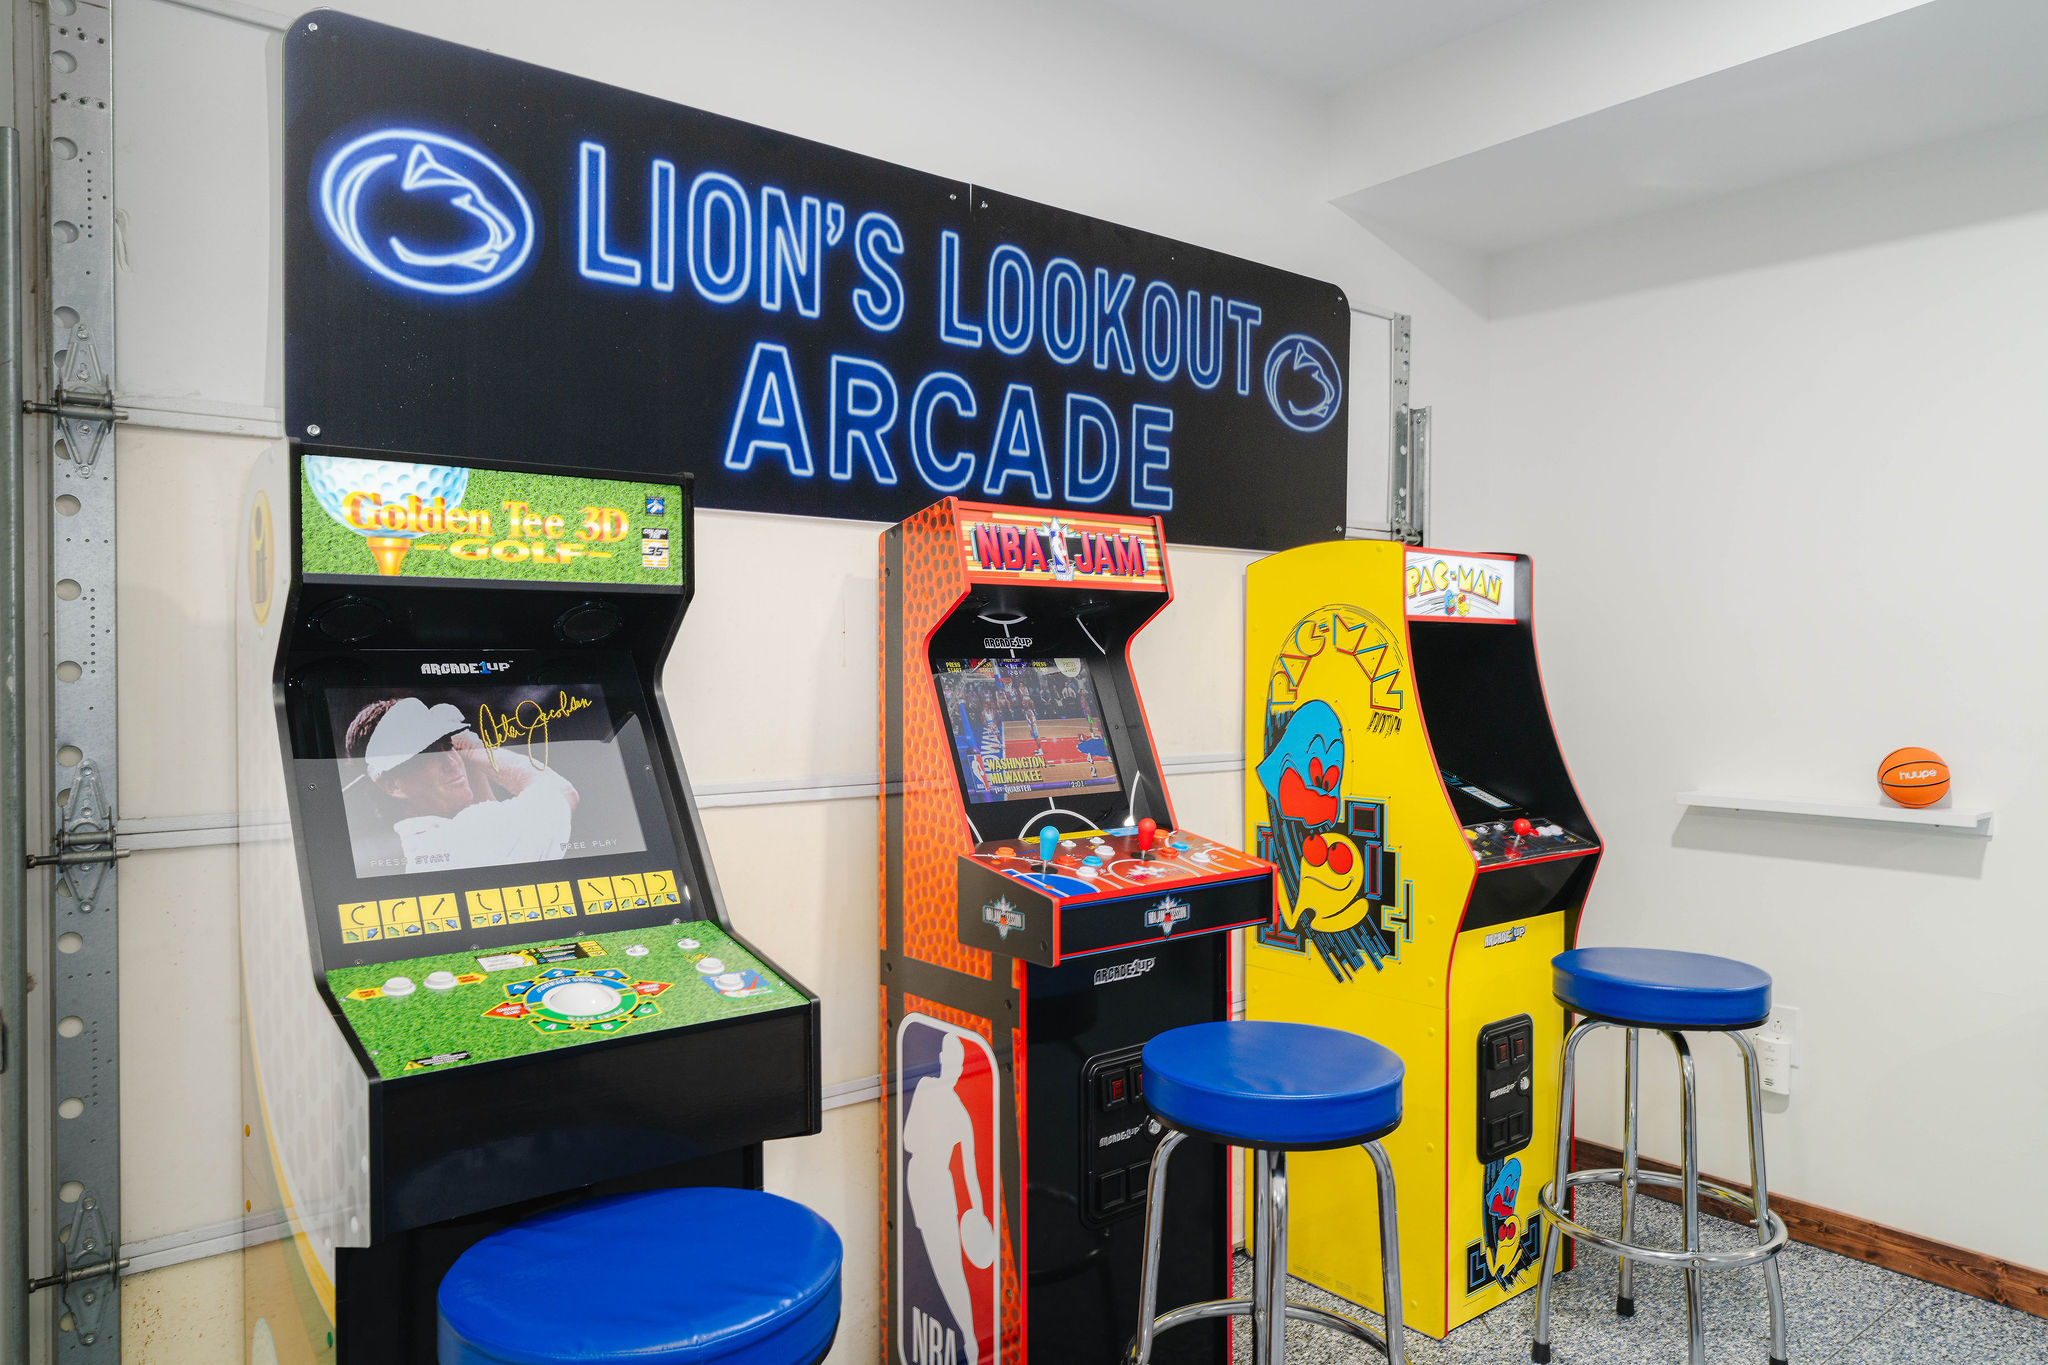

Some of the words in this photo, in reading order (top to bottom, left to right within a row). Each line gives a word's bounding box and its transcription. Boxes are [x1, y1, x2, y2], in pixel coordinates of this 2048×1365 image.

[578, 140, 906, 332] LION'S
[940, 228, 1263, 396] LOOKOUT
[723, 341, 1174, 511] ARCADE
[341, 490, 493, 536] Golden
[502, 500, 566, 540] Tee
[576, 505, 631, 543] 3D
[449, 537, 587, 565] GOLF
[974, 522, 1050, 572] NBA
[1074, 531, 1146, 577] JAM
[1405, 559, 1502, 606] PAC-MAN
[985, 757, 1048, 771] WASHINGTON
[990, 770, 1044, 785] MILWAUKEE
[415, 853, 451, 865] START
[591, 838, 618, 848] PLAY
